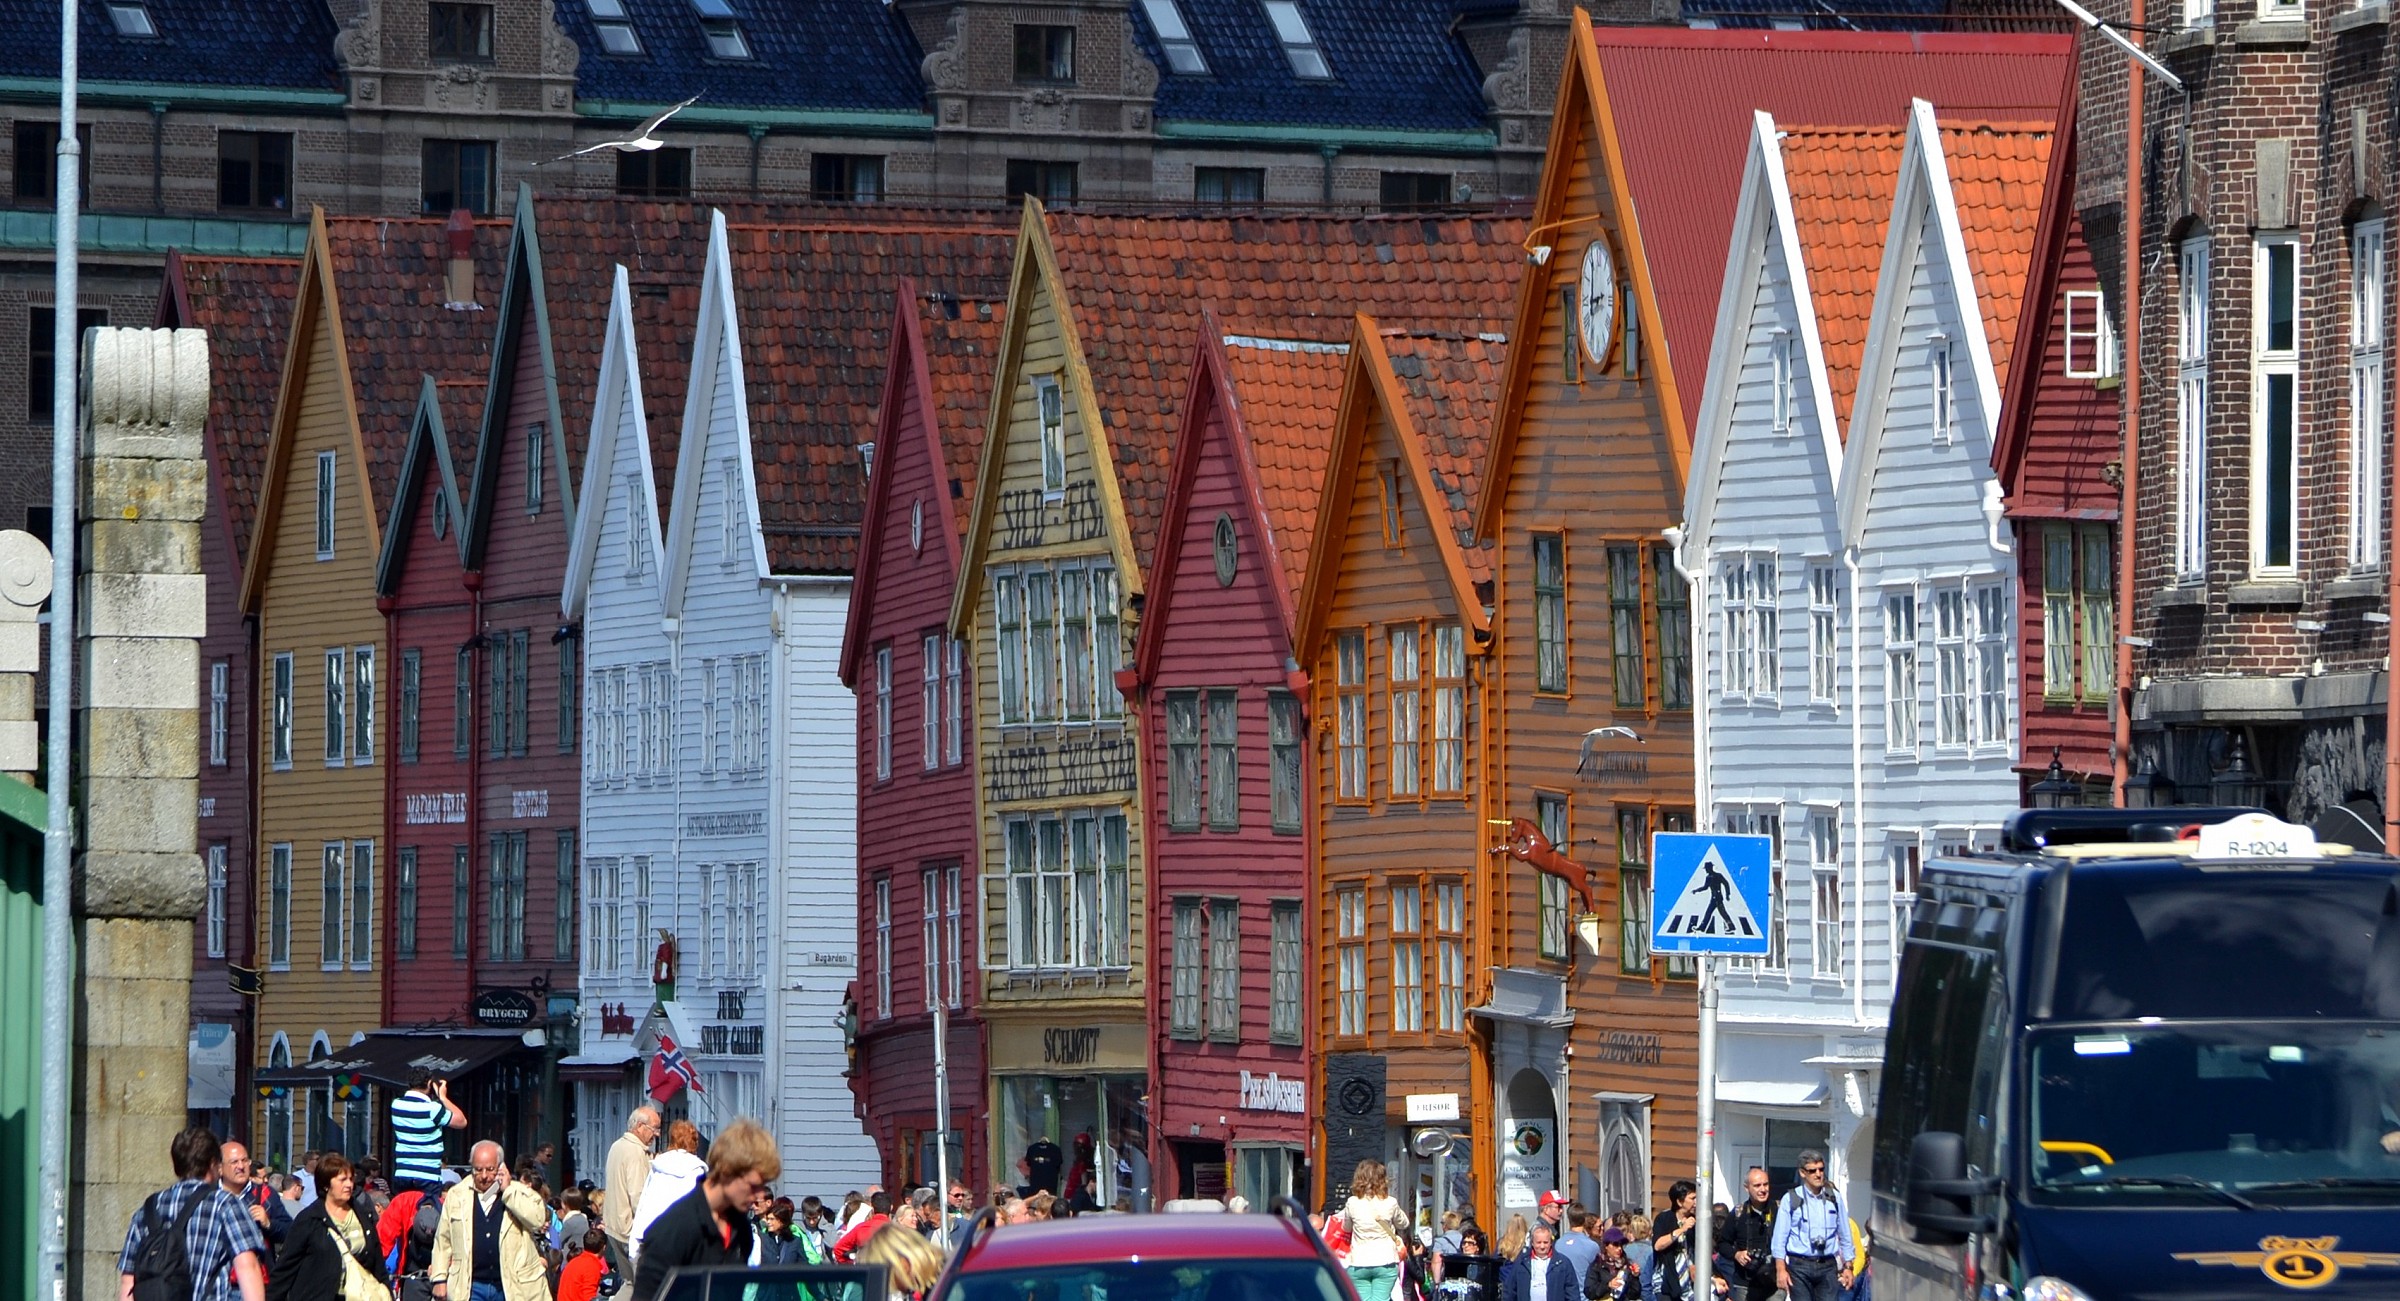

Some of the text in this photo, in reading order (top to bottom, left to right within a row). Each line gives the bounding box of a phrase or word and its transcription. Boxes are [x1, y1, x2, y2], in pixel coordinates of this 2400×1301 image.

[1003, 488, 1045, 549] SILD
[991, 746, 1048, 801] ALFRED
[2228, 841, 2288, 855] R-1204
[479, 1008, 529, 1018] BRYGGEN
[1044, 1027, 1100, 1064] SCHJØTT
[2284, 1256, 2315, 1277] 1
